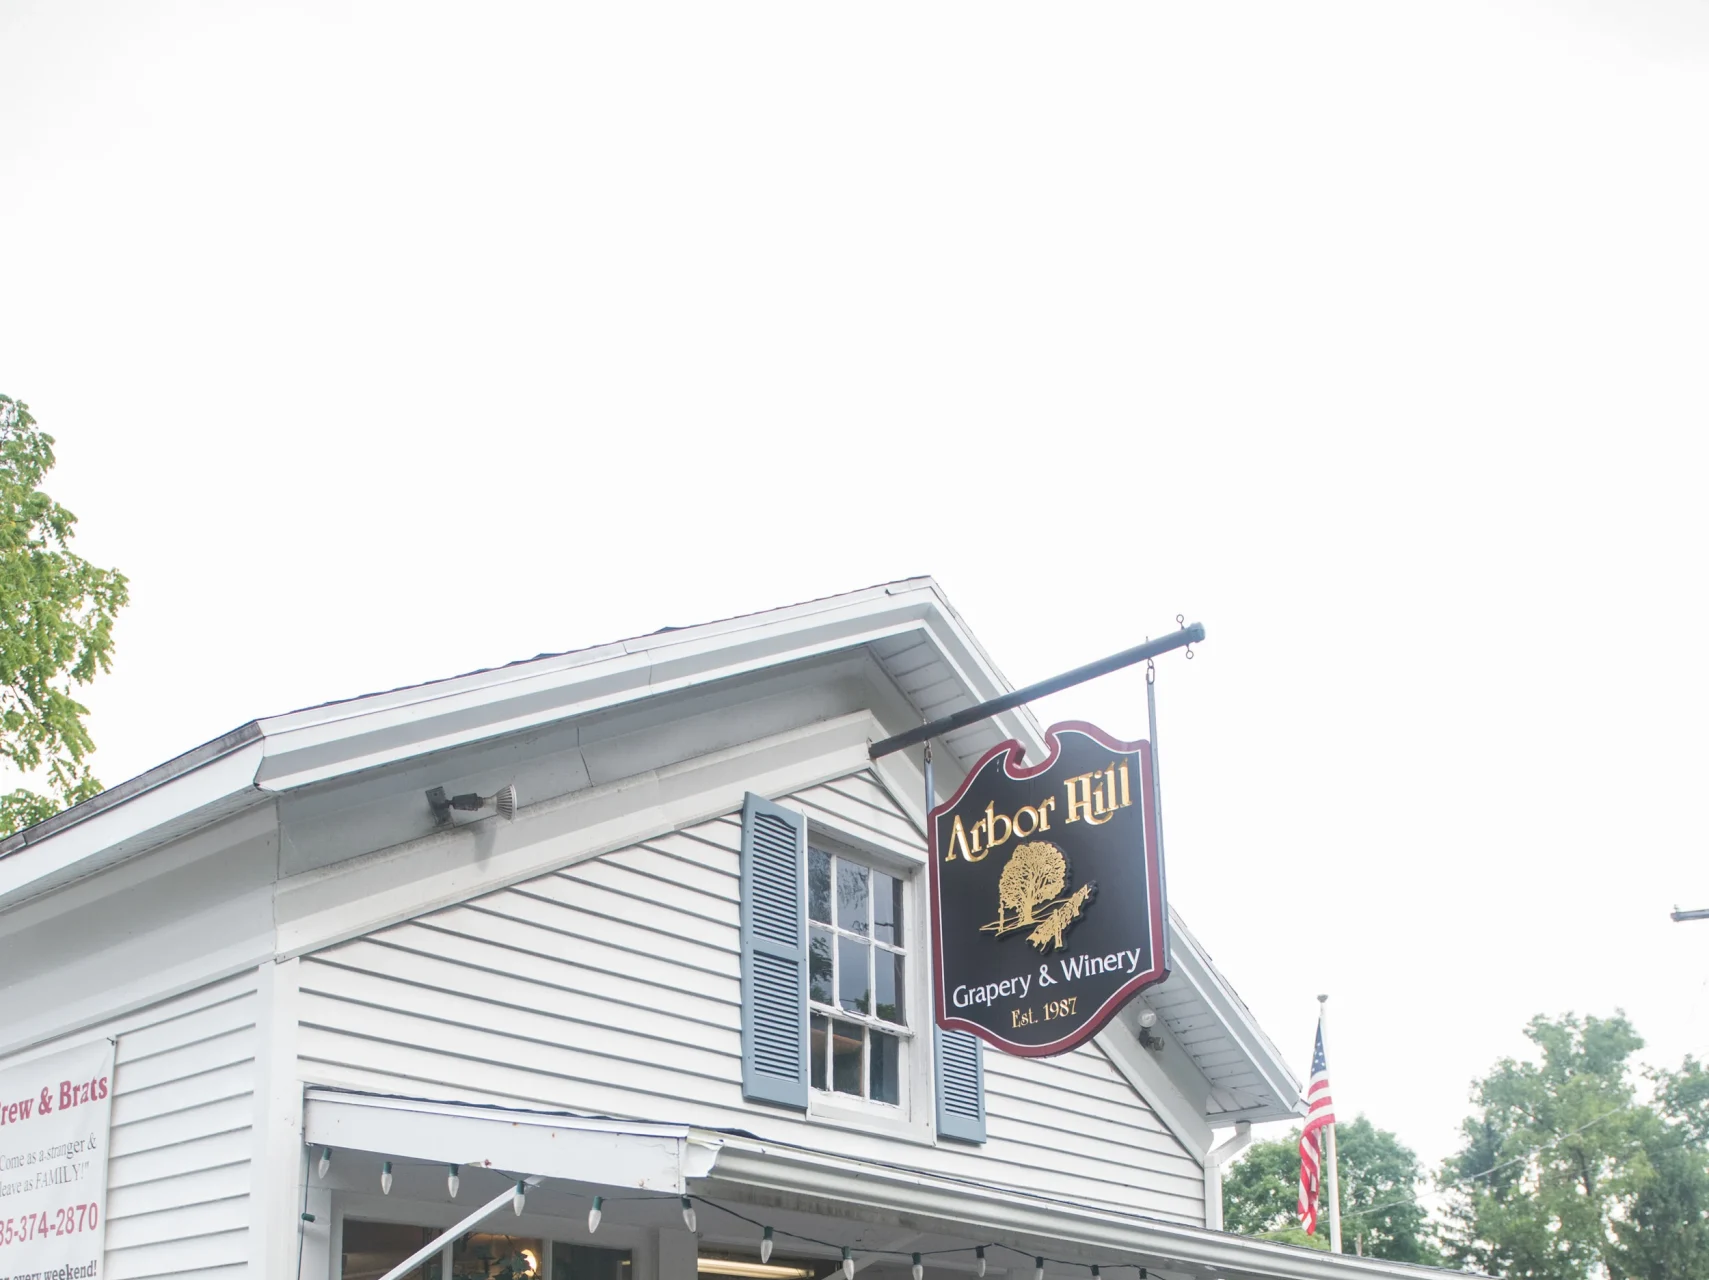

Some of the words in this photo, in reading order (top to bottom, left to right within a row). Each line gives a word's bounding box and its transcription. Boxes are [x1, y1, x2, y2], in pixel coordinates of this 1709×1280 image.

[945, 796, 1056, 862] Arbor
[1063, 757, 1133, 825] Hill
[952, 973, 1032, 1008] Grapery
[1038, 963, 1058, 988] &
[1060, 948, 1141, 974] Winery
[1011, 1009, 1038, 1029] Est.
[1043, 997, 1078, 1022] 1987
[0, 1098, 34, 1126] rew
[38, 1086, 53, 1116] &
[58, 1076, 108, 1111] Brats
[27, 1151, 37, 1166] as
[87, 1132, 97, 1150] &
[24, 1178, 34, 1193] as
